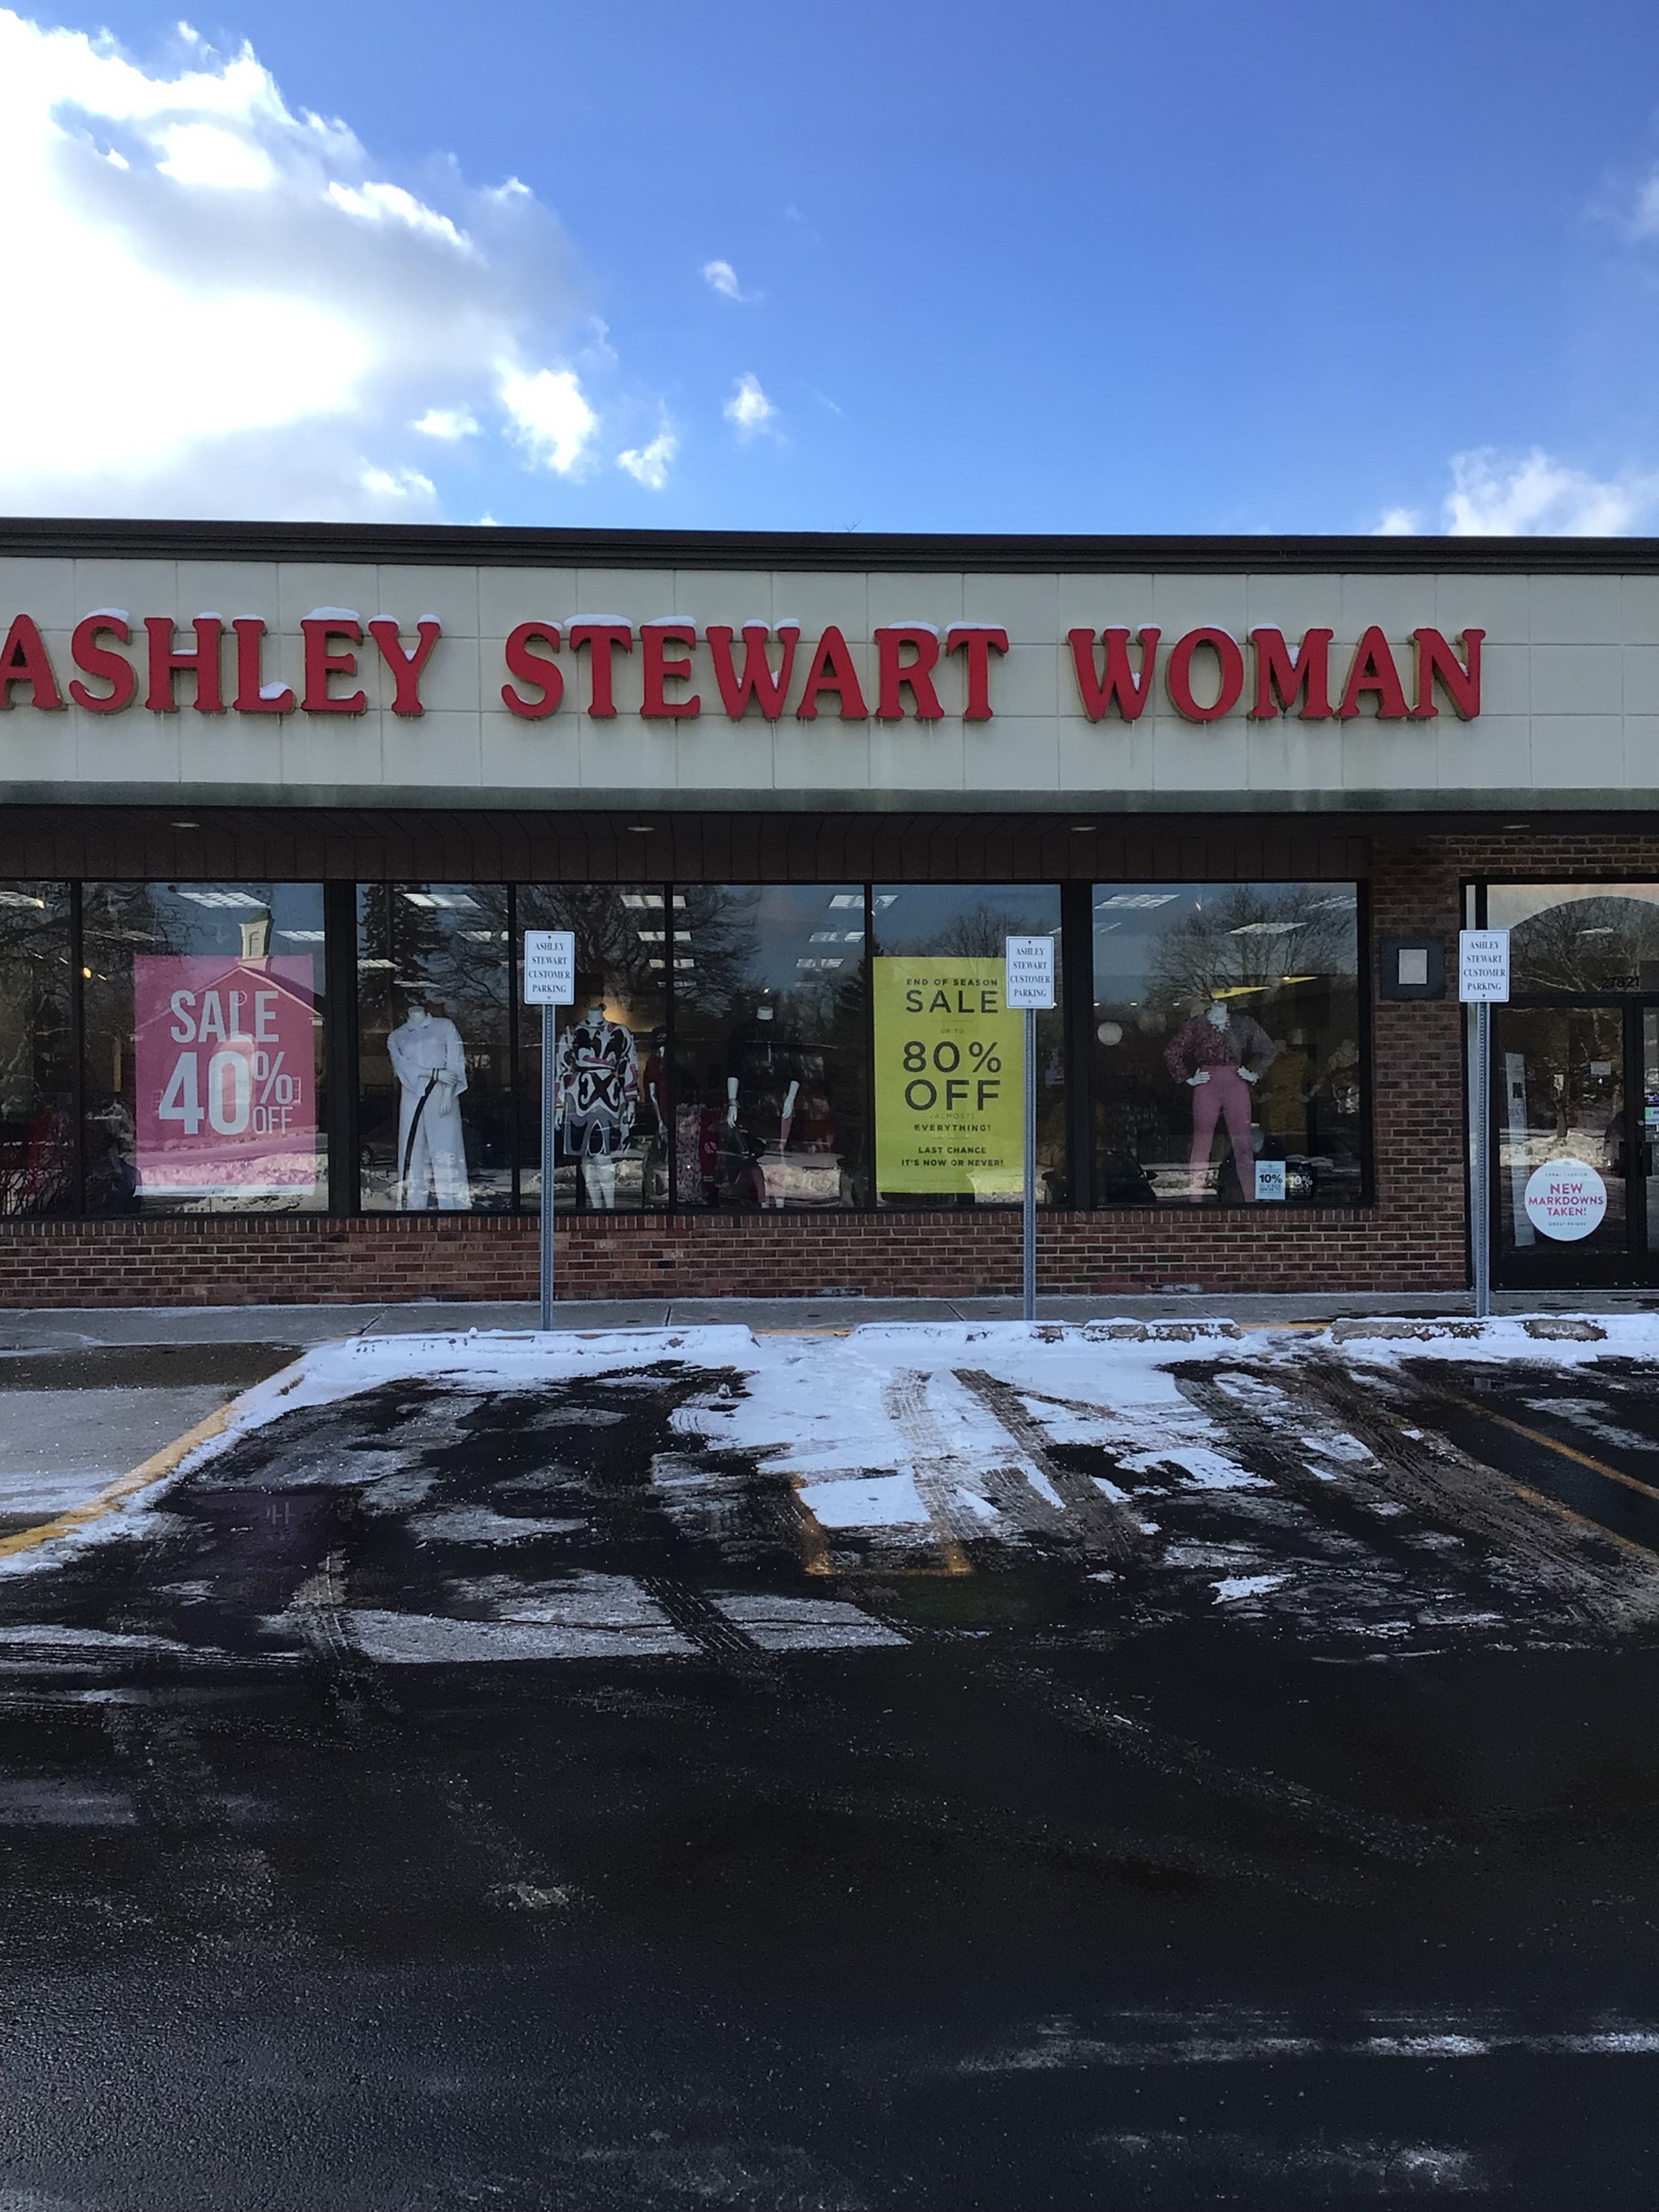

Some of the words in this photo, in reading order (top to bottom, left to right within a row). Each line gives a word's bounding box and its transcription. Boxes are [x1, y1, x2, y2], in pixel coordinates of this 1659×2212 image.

[0, 613, 441, 713] ASHLEY
[501, 620, 1009, 720] STEWART
[1067, 625, 1486, 722] WOMAN
[1016, 947, 1044, 956] ASHLEY
[532, 956, 567, 964] STEWART
[1467, 955, 1502, 963] STEWART
[1013, 961, 1047, 969] STEWART
[529, 970, 571, 979] CUSTOMER
[1464, 968, 1506, 977] CUSTOMER
[1010, 975, 1050, 983] CUSTOMER
[532, 985, 567, 993] PARKING
[1014, 989, 1046, 997] PARKING
[905, 989, 998, 1013] SALE
[170, 990, 279, 1043] SALE
[903, 1040, 1002, 1073] 80%
[159, 1051, 293, 1135] 40%
[905, 1079, 1000, 1111] OFF
[252, 1106, 293, 1134] OFF
[1259, 1174, 1283, 1183] 10%
[1550, 1183, 1583, 1194] NEW
[1528, 1196, 1604, 1205] MARKDOWNS
[1547, 1207, 1587, 1216] TAKEN!
